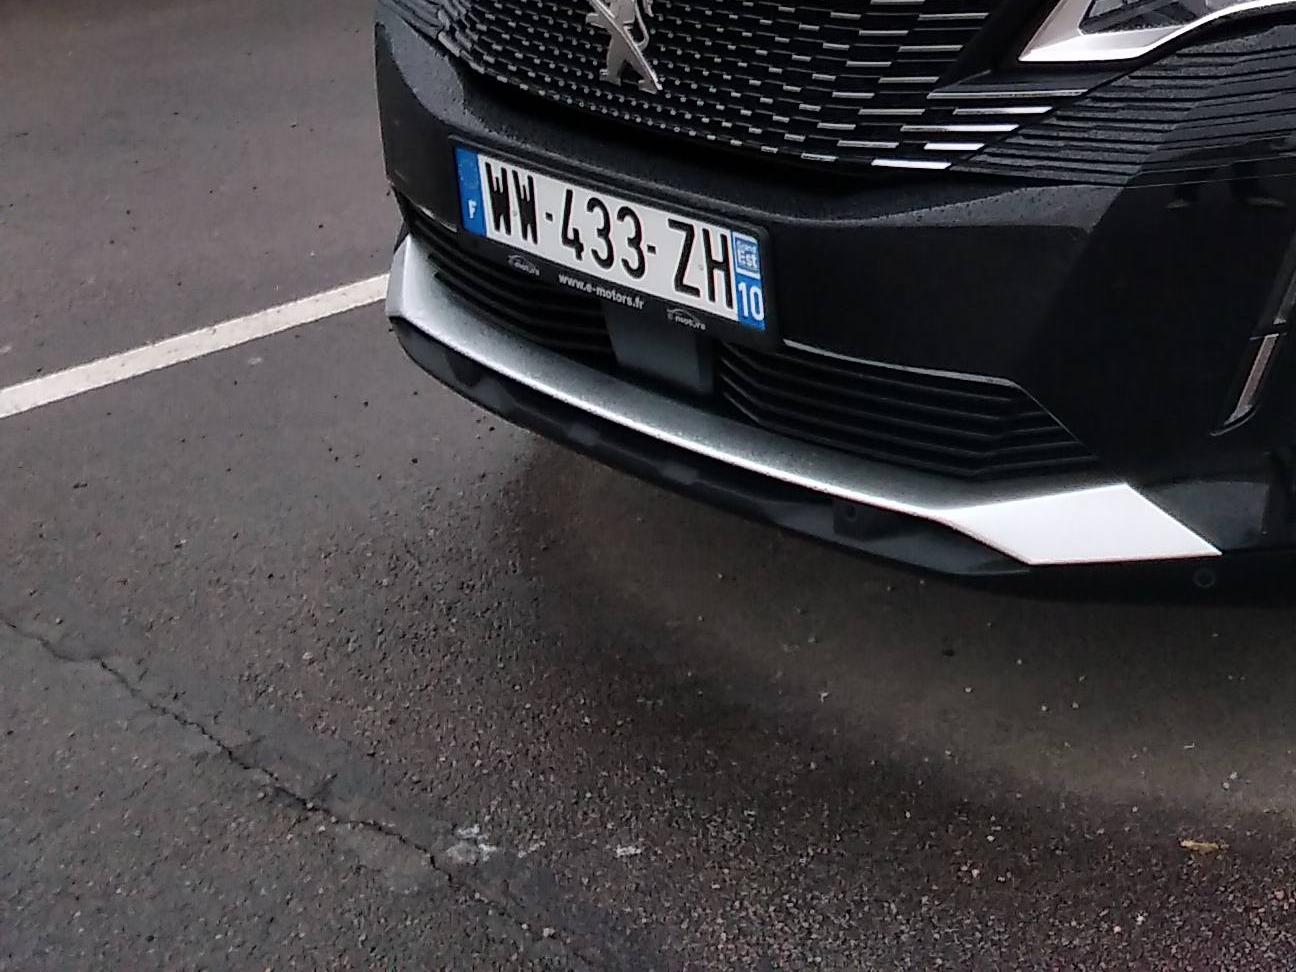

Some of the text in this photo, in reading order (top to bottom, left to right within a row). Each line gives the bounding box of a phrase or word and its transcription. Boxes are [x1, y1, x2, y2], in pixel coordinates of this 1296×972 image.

[467, 199, 477, 219] F
[484, 161, 734, 310] WW-433-ZH
[737, 248, 758, 269] Est
[558, 272, 645, 311] www.e-motors.fr
[738, 281, 765, 321] 10
